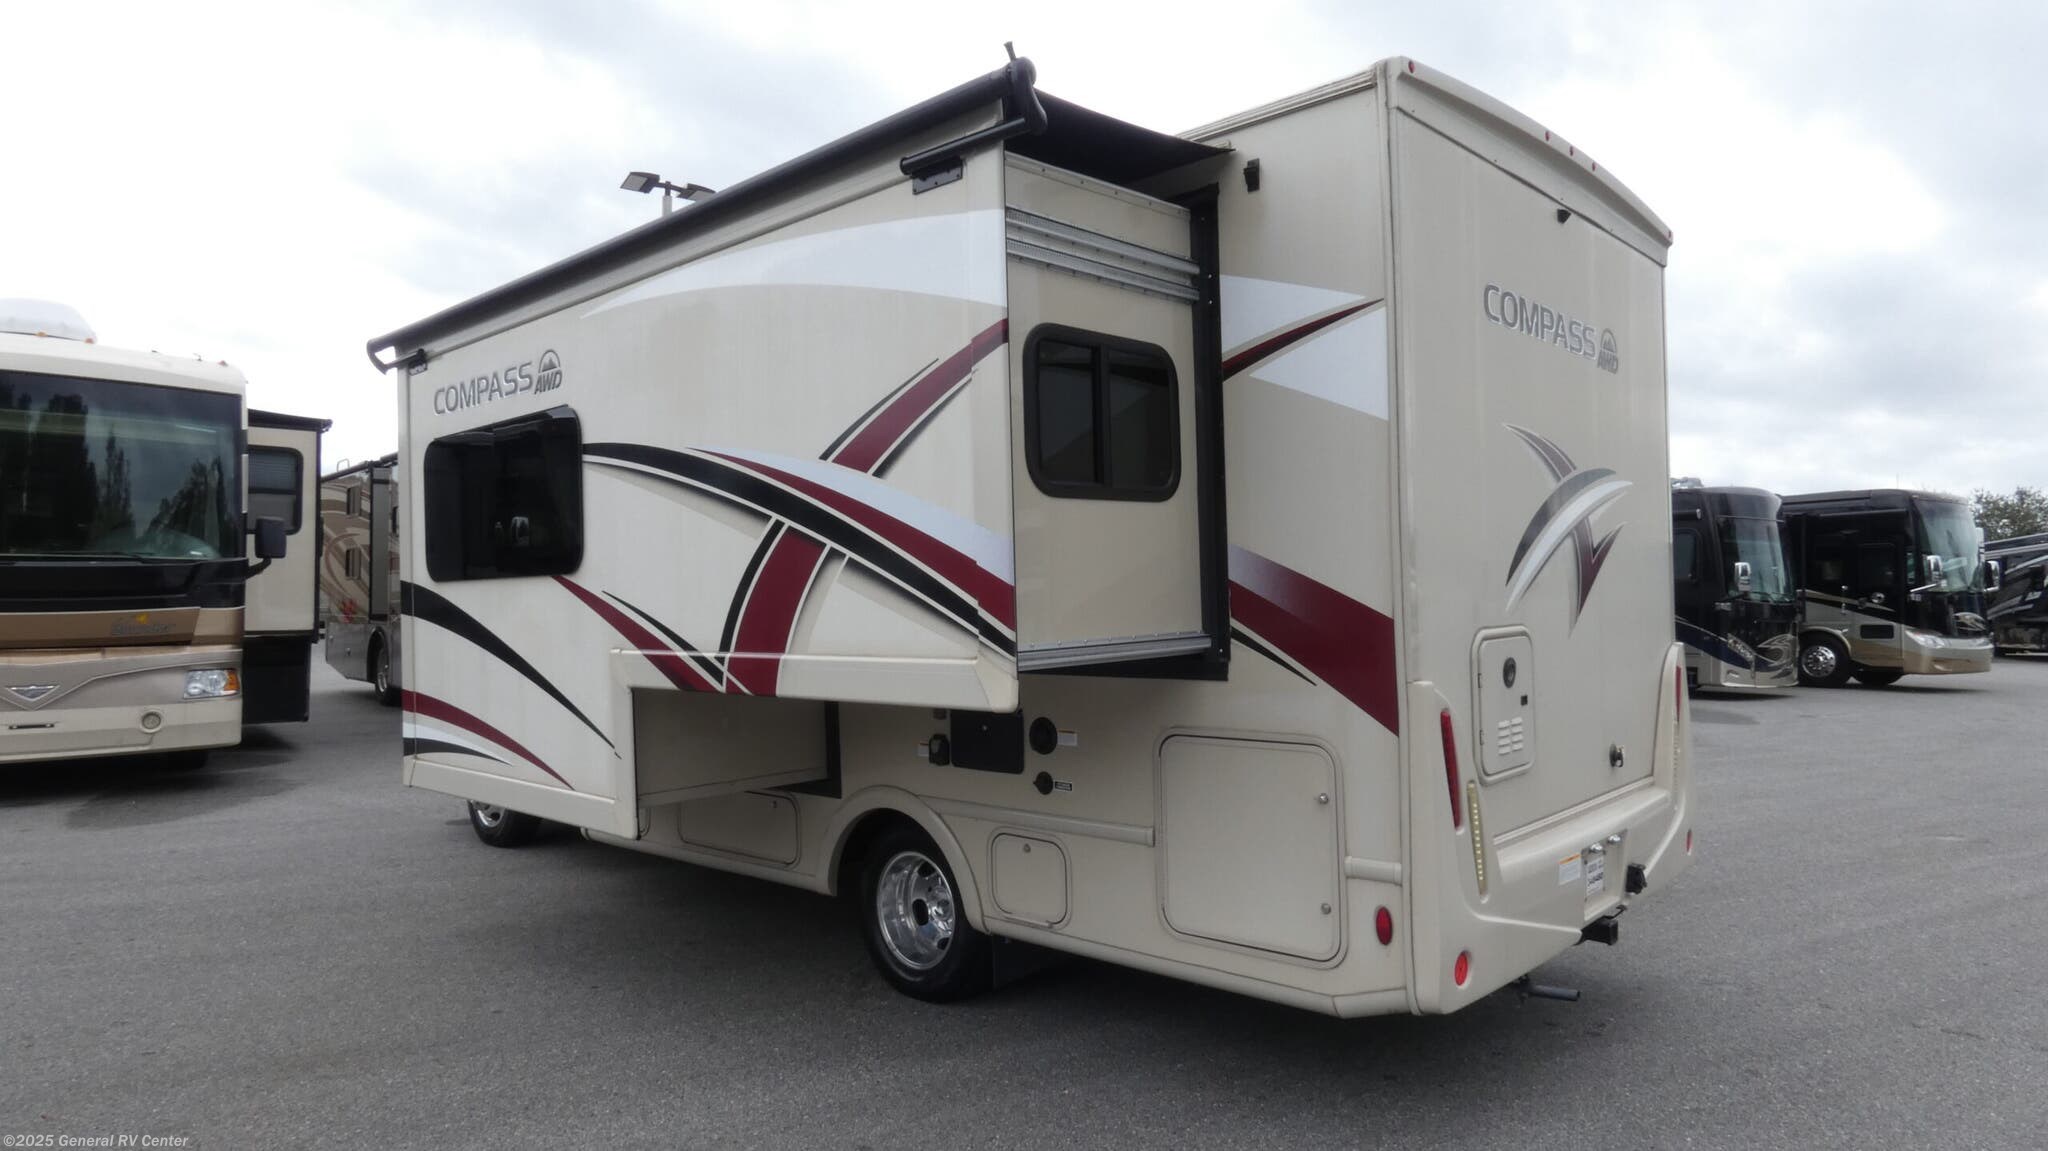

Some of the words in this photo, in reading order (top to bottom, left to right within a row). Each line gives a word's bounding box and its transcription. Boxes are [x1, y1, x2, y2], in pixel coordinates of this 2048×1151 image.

[1483, 284, 1597, 359] COMPASS
[1597, 350, 1619, 374] AWD
[434, 361, 533, 414] COMPASS
[534, 370, 563, 395] AWD
